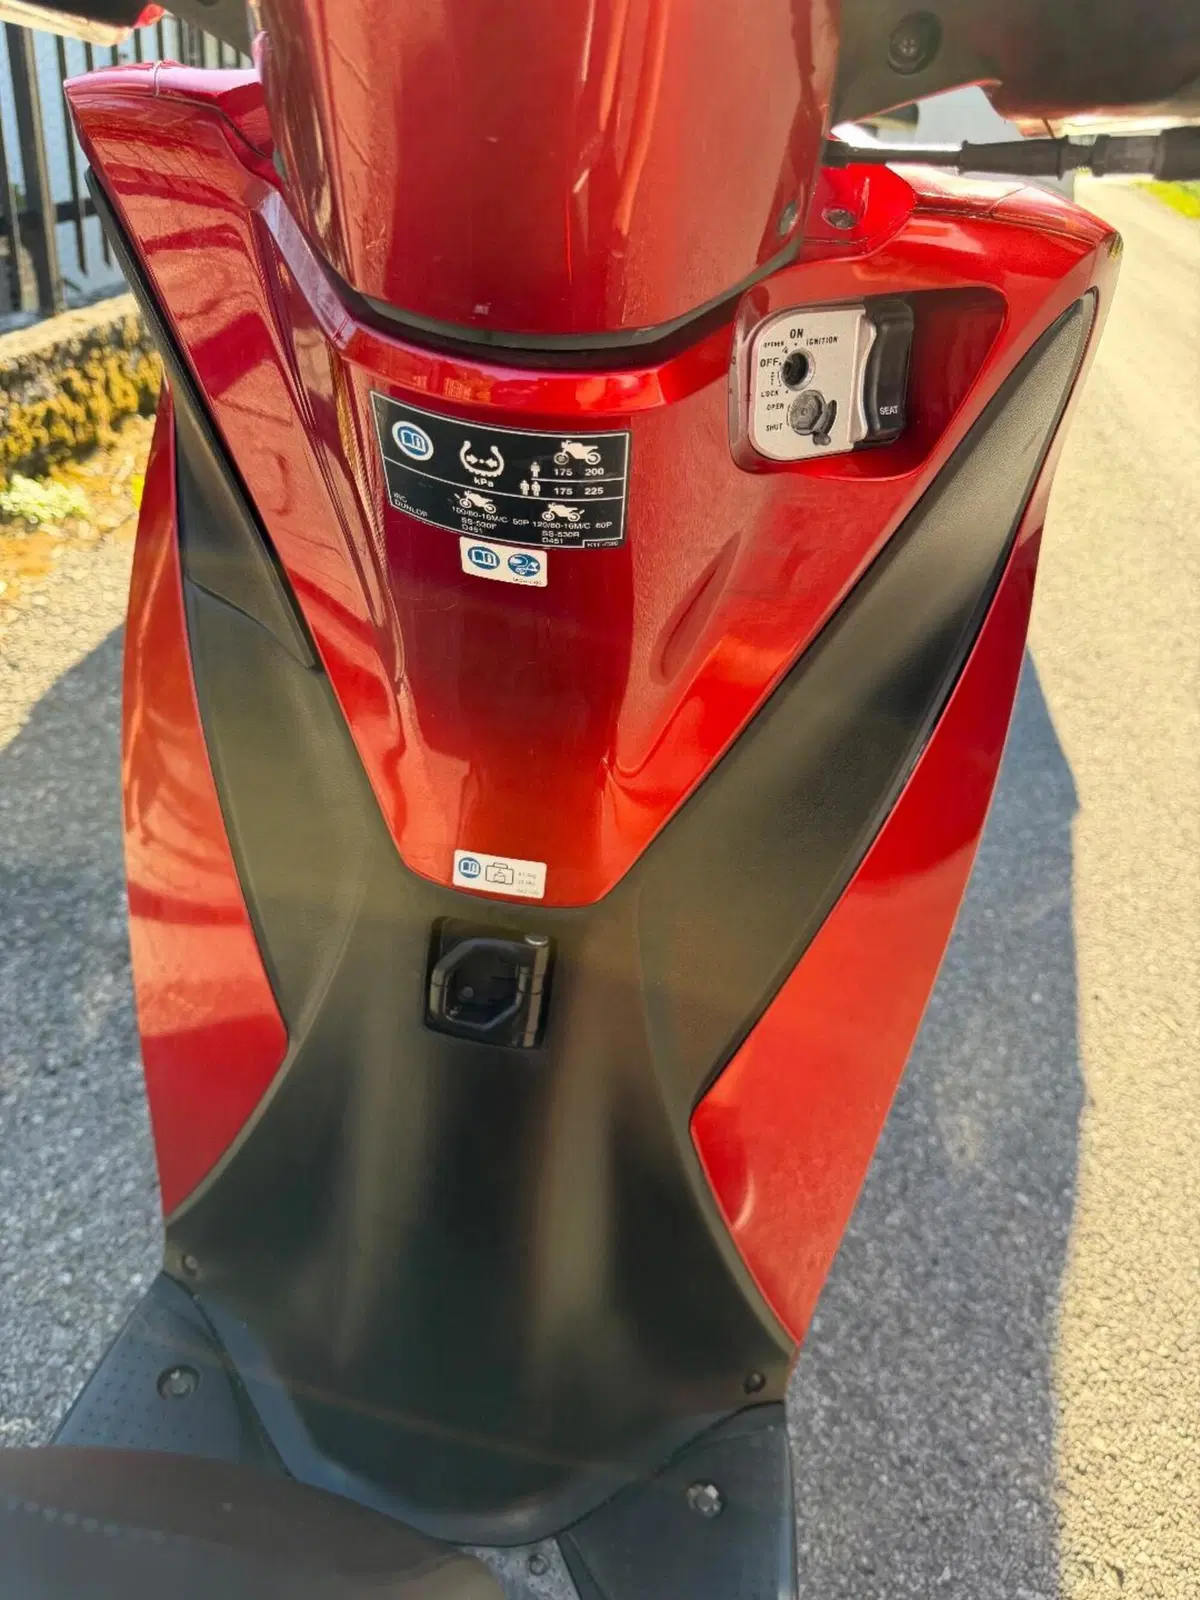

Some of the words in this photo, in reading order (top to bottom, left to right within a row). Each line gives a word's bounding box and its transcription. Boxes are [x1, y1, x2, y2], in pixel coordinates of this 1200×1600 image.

[790, 328, 804, 339] ON
[763, 340, 784, 348] OPENER
[806, 336, 838, 346] IGNITION
[760, 357, 779, 367] OFF
[761, 390, 779, 398] LOCK
[766, 402, 785, 411] OPEN
[879, 405, 899, 415] SEAT
[765, 423, 783, 432] SHUT
[553, 468, 573, 476] 175
[584, 468, 605, 476] 200
[474, 477, 494, 487] kPa
[553, 487, 573, 495] 175
[584, 487, 604, 495] 225
[394, 498, 428, 517] DUNLOP
